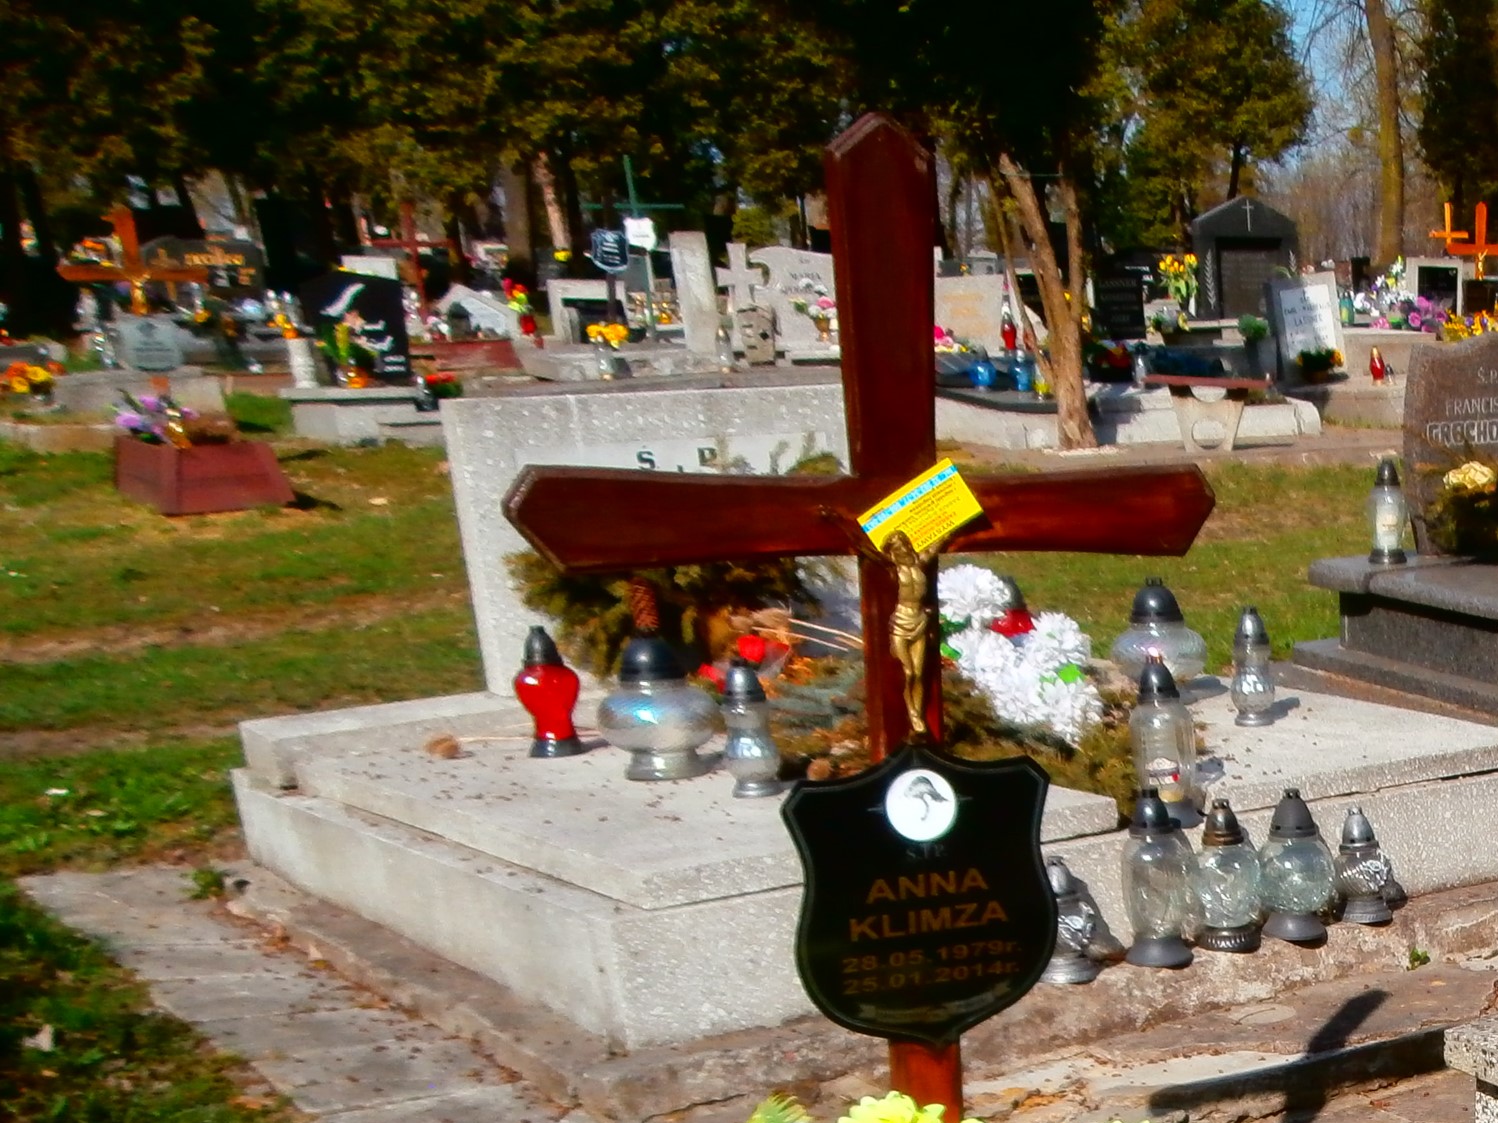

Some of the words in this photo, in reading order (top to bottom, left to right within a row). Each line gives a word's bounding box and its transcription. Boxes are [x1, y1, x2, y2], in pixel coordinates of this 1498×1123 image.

[865, 866, 990, 905] ANNA
[848, 899, 1010, 943] KLIMZA
[841, 938, 1023, 974] 28.05.1979r.
[841, 959, 1021, 996] 25.01.2014r.
